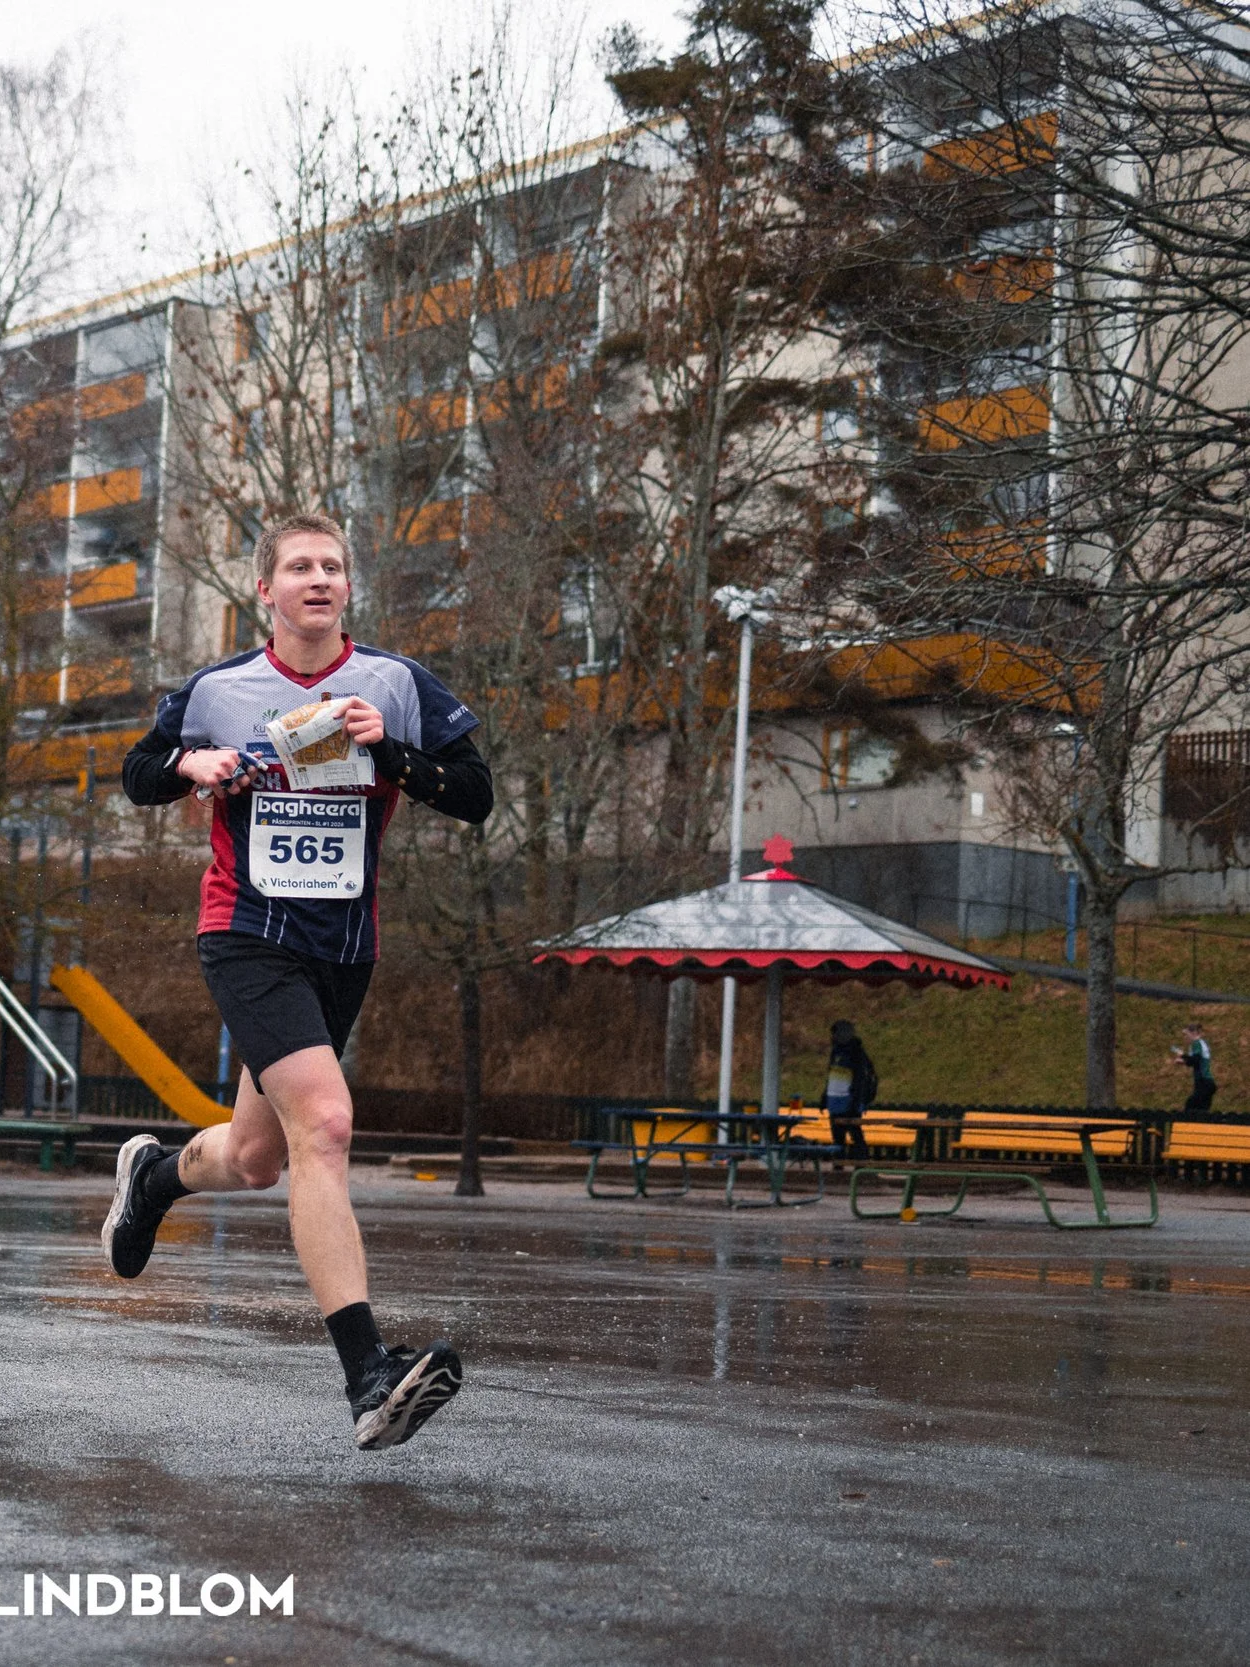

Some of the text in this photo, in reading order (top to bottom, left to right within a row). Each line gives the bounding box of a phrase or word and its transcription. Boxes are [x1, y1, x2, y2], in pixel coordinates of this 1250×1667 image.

[257, 798, 360, 818] bagheera
[271, 818, 311, 826] PÅSKSPRINTEN
[268, 834, 344, 865] 565
[270, 877, 338, 889] Victoriahem
